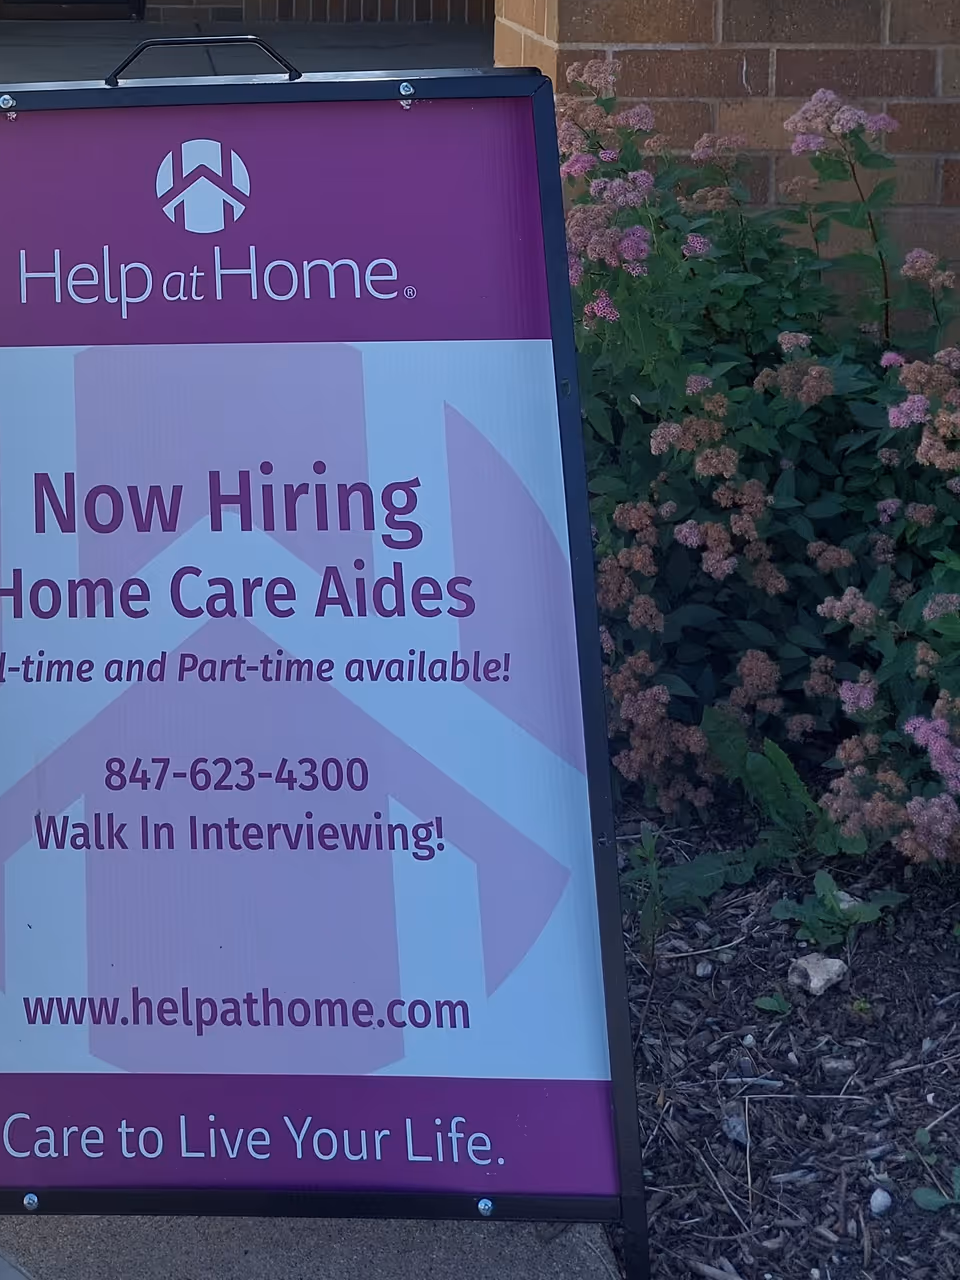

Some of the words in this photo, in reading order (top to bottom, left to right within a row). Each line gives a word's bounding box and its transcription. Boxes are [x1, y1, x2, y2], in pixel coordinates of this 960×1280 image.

[20, 245, 152, 318] Help
[163, 265, 204, 300] at
[34, 473, 182, 533] Now
[209, 461, 424, 550] Hiring
[170, 567, 296, 618] Care
[315, 560, 476, 617] Aides
[104, 652, 166, 682] and
[177, 649, 335, 682] Part-time
[344, 649, 511, 682] available!
[104, 757, 369, 792] 847-623-4300
[35, 811, 129, 850] Walk
[141, 815, 174, 850] In
[189, 811, 445, 861] Interviewing!
[23, 987, 470, 1038] www.helpathome.com
[2, 1112, 105, 1159] Care
[118, 1120, 163, 1159] to
[179, 1114, 271, 1159] Live
[284, 1116, 391, 1161] Your
[406, 1117, 505, 1166] Life.
